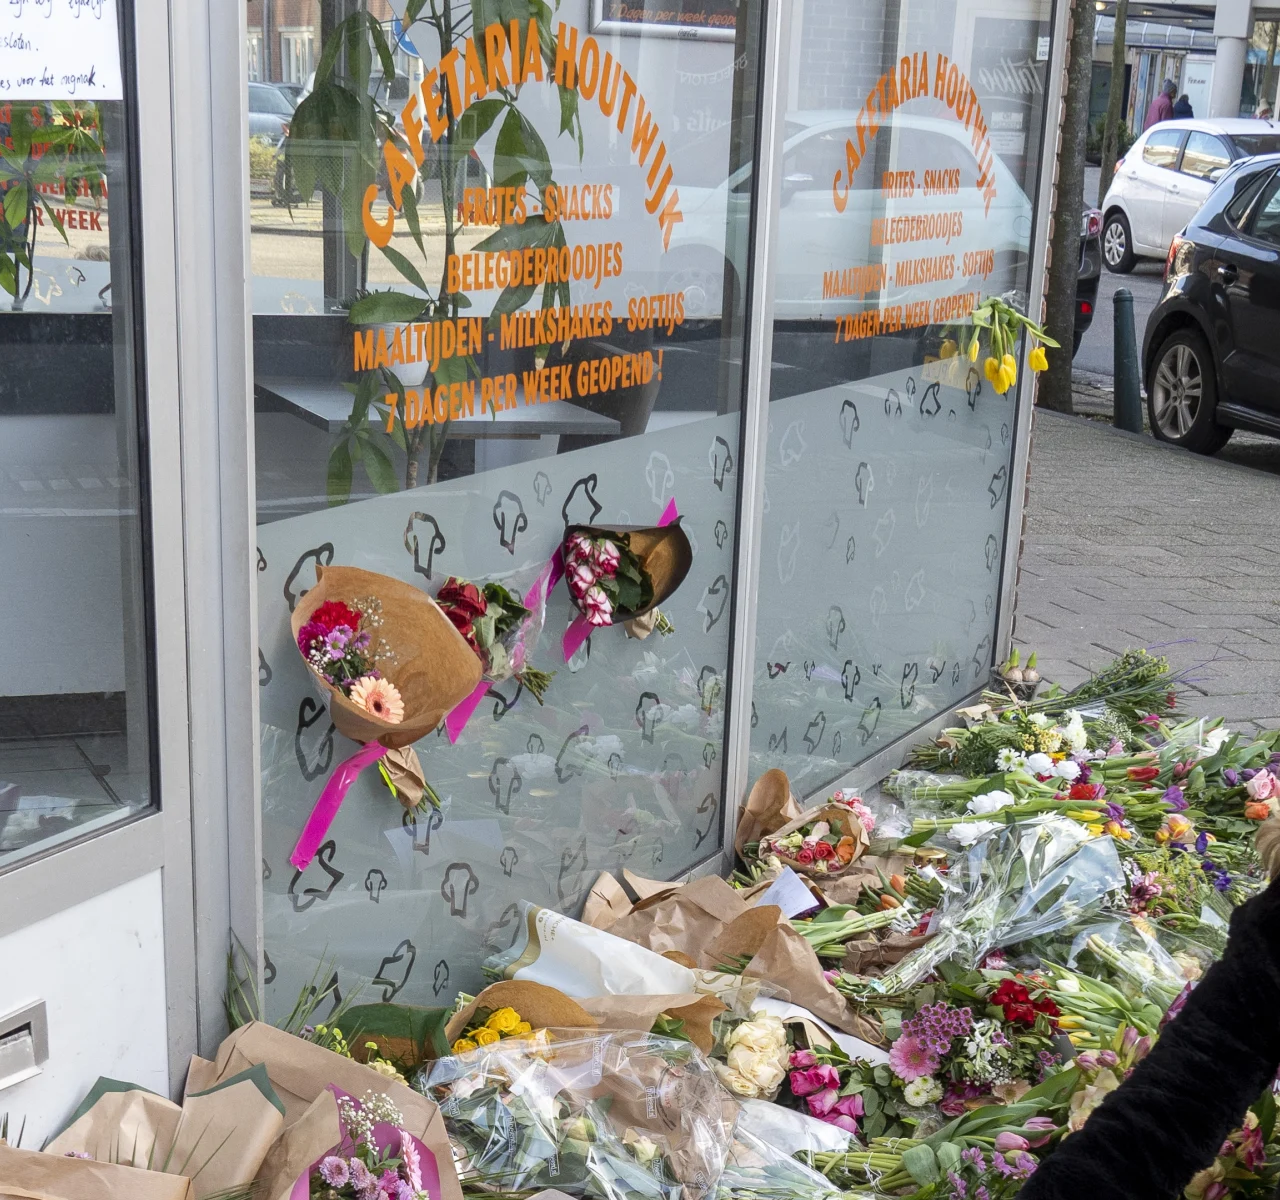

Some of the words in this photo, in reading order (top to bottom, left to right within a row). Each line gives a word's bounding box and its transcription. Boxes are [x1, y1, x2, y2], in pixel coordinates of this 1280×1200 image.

[362, 18, 543, 248] CAFETARIA
[555, 22, 683, 253] HOUTWIJK
[832, 51, 929, 214] CAFETARIA
[933, 53, 997, 219] HOUTWIJK
[463, 186, 527, 227] FRITES
[544, 184, 613, 223] SNACKS
[881, 170, 916, 199] FRITES
[923, 168, 961, 197] SNACKS
[871, 211, 963, 247] BELEGDEBROODJES
[447, 241, 624, 295] BELEGDEBROODJES
[822, 263, 888, 302] MAALTIJDEN
[895, 254, 956, 289] MILKSHAKES
[962, 249, 995, 281] SOFTIJS
[354, 318, 483, 373] MAALTIJDEN
[500, 303, 613, 352] MILKSHAKES
[627, 292, 686, 337] SOFTIJS
[834, 316, 843, 344] 7
[844, 309, 881, 342] DAGEN
[882, 303, 902, 334] PER
[905, 299, 931, 330] WEEK
[384, 393, 398, 434] 7
[405, 381, 475, 431] DAGEN
[481, 373, 518, 415] PER
[523, 364, 573, 406] WEEK
